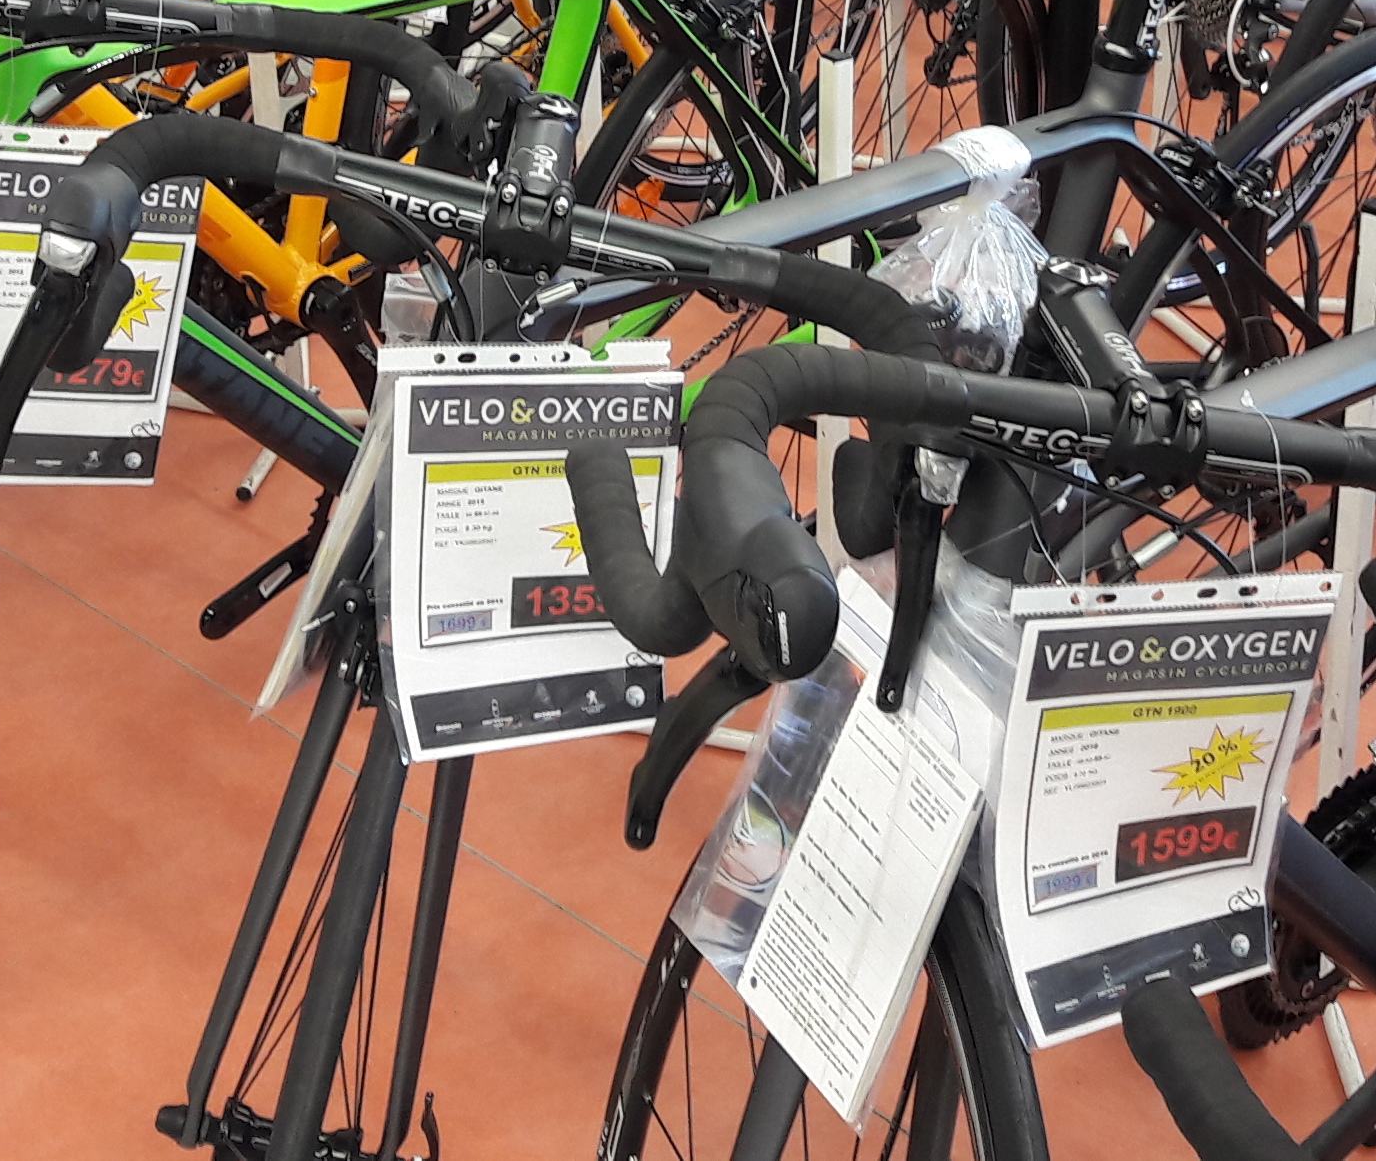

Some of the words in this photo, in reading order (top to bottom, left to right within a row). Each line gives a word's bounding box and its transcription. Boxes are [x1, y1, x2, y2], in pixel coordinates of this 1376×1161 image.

[482, 428, 558, 441] MAGASIN
[565, 426, 673, 440] CYCLEUROPE
[1106, 666, 1187, 684] MAGASIN
[1194, 659, 1311, 680] CYCLEUROPE
[1193, 752, 1217, 773] 20
